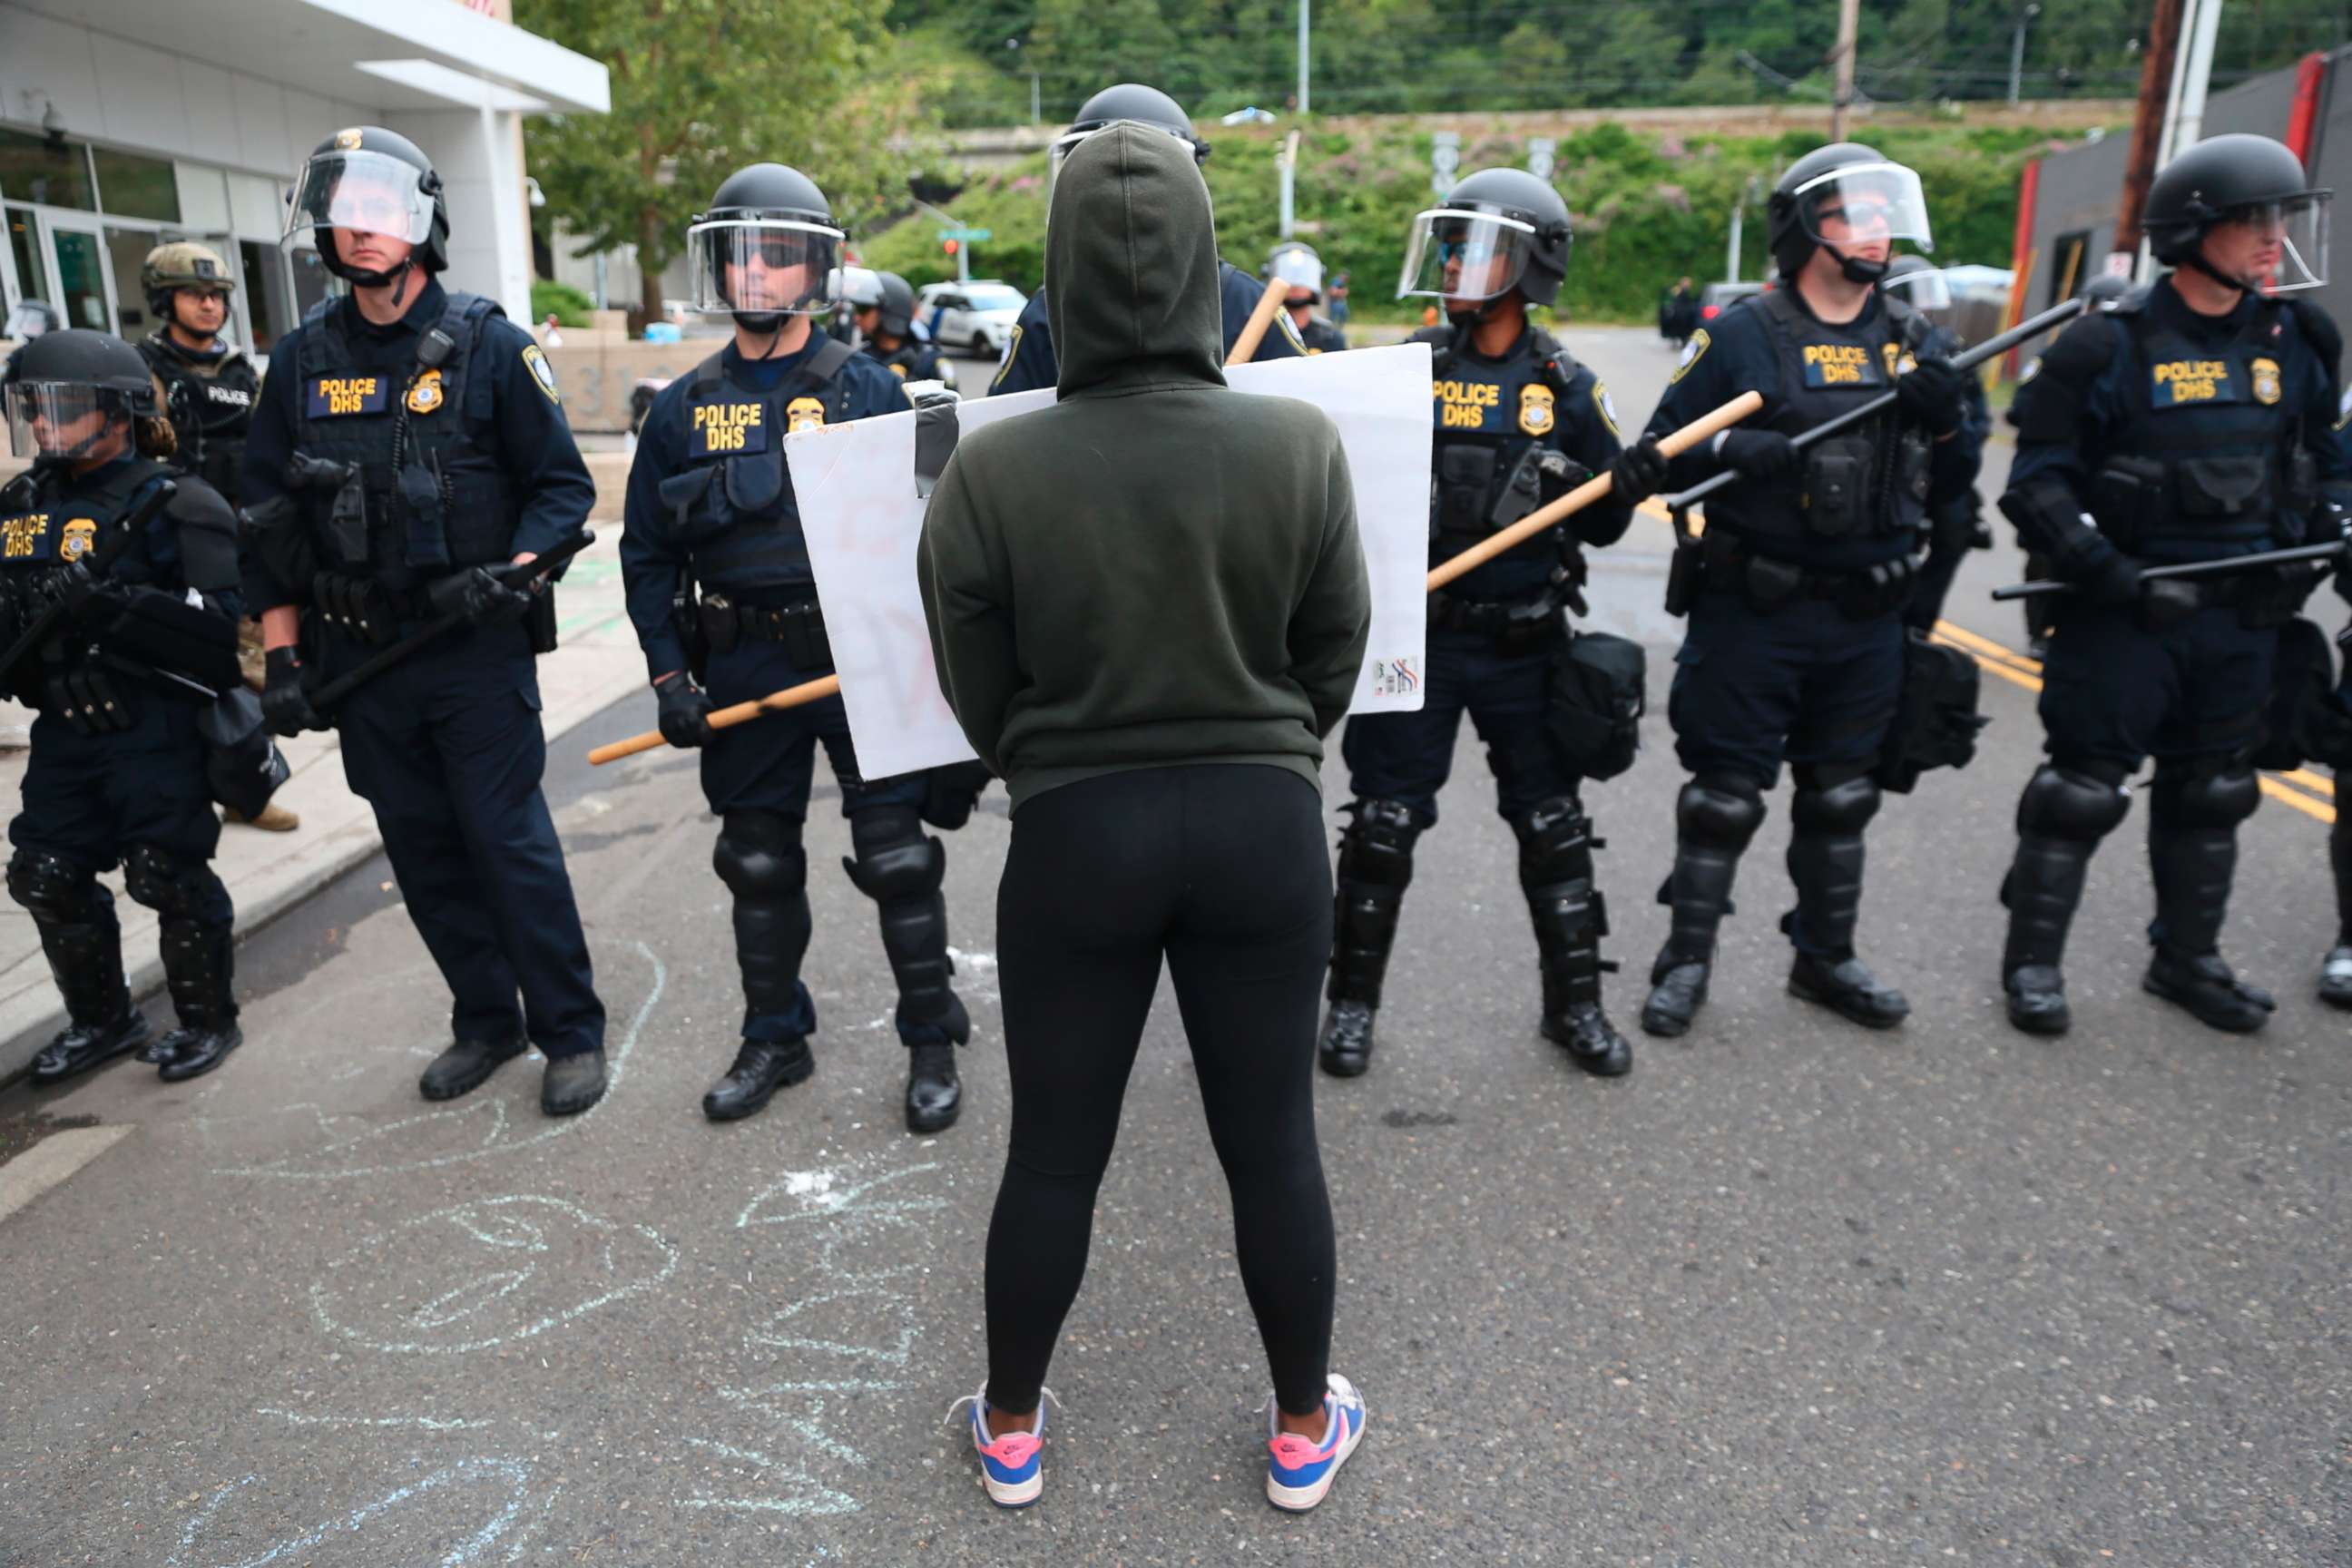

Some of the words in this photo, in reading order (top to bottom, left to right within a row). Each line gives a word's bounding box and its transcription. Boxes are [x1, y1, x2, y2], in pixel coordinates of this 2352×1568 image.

[1803, 345, 1868, 366] POLICE
[1822, 362, 1861, 384] DHS
[2153, 360, 2228, 385] POLICE
[208, 386, 251, 406] POLICE
[319, 377, 377, 397] POLICE
[1434, 380, 1500, 407] POLICE
[2171, 378, 2216, 403] DHS
[330, 394, 363, 414] DHS
[1442, 404, 1483, 427] DHS
[694, 403, 762, 430] POLICE
[706, 426, 746, 451] DHS
[0, 514, 49, 538] POLICE
[5, 535, 34, 557] DHS
